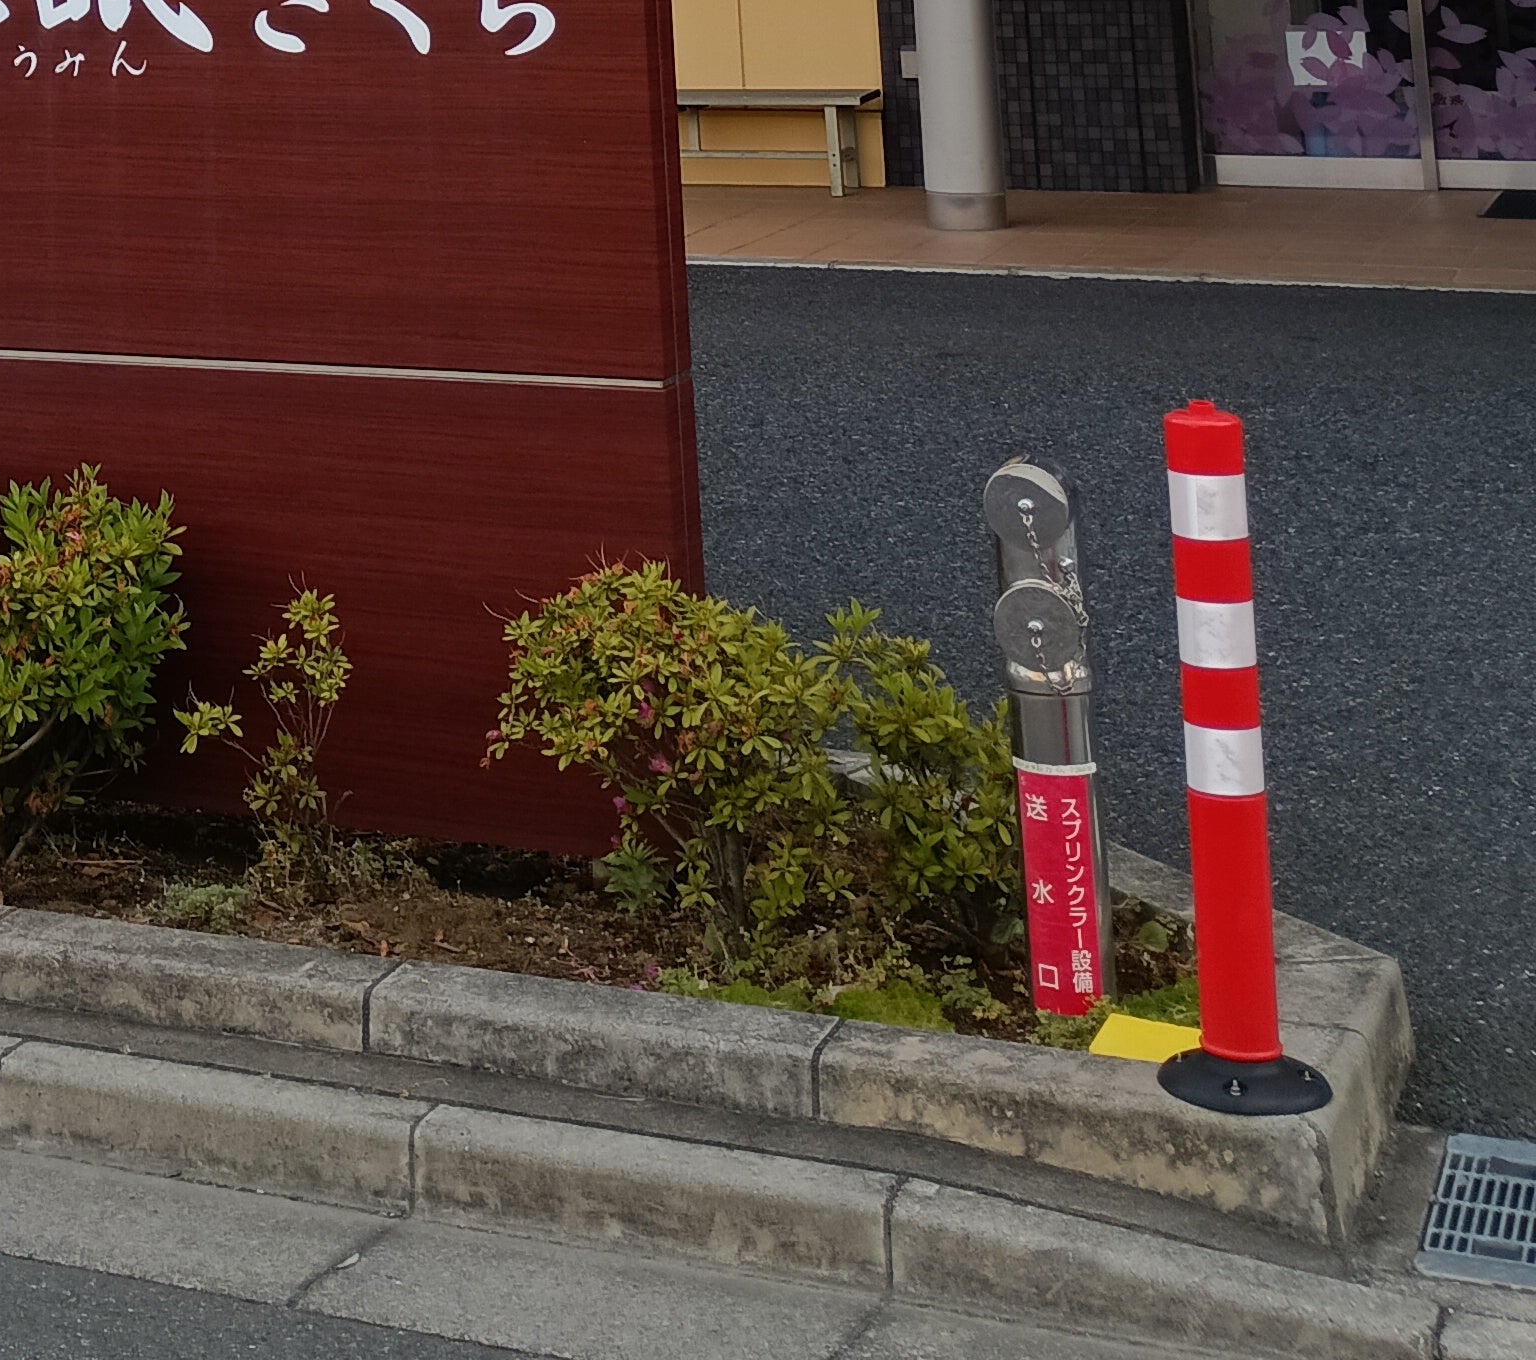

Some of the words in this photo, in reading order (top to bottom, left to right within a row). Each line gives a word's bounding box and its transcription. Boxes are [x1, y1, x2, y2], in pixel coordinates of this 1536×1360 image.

[1061, 797, 1094, 994] スプリンクラー設備
